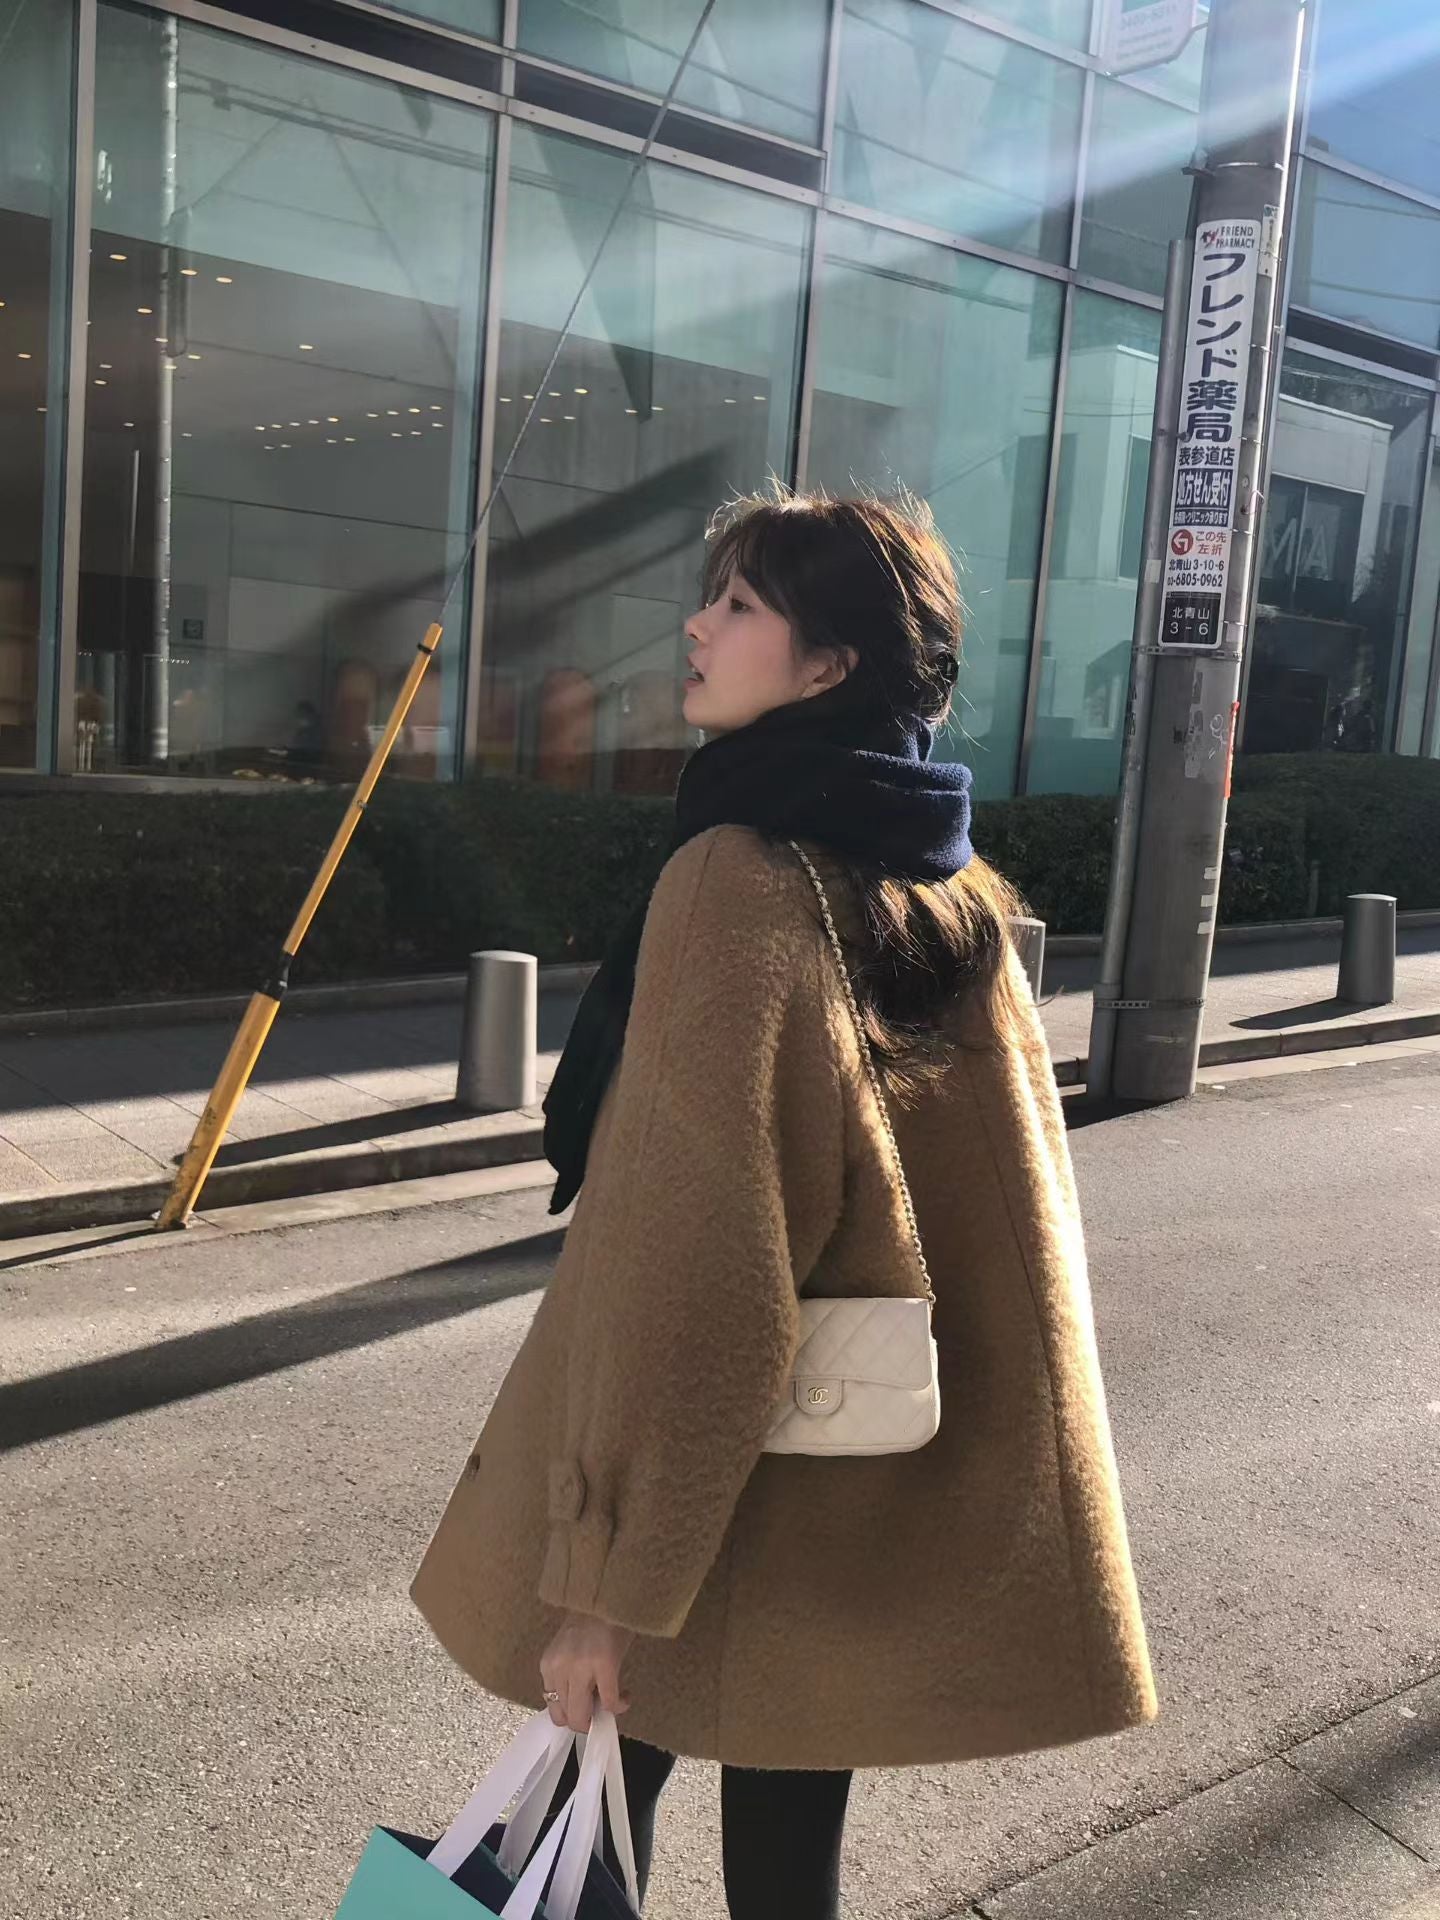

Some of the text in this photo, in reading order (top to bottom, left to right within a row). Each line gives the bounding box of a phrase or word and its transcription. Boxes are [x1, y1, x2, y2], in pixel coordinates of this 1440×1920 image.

[1220, 225, 1254, 237] FRIEND
[1215, 238, 1255, 249] PHARMACY
[1184, 252, 1246, 443] フレンド薬局
[1178, 446, 1235, 467] 表参道店
[1176, 471, 1231, 506] 処方せん受付
[1195, 531, 1227, 543] この先
[1197, 544, 1223, 556] 左折
[1172, 606, 1210, 620] 北青山
